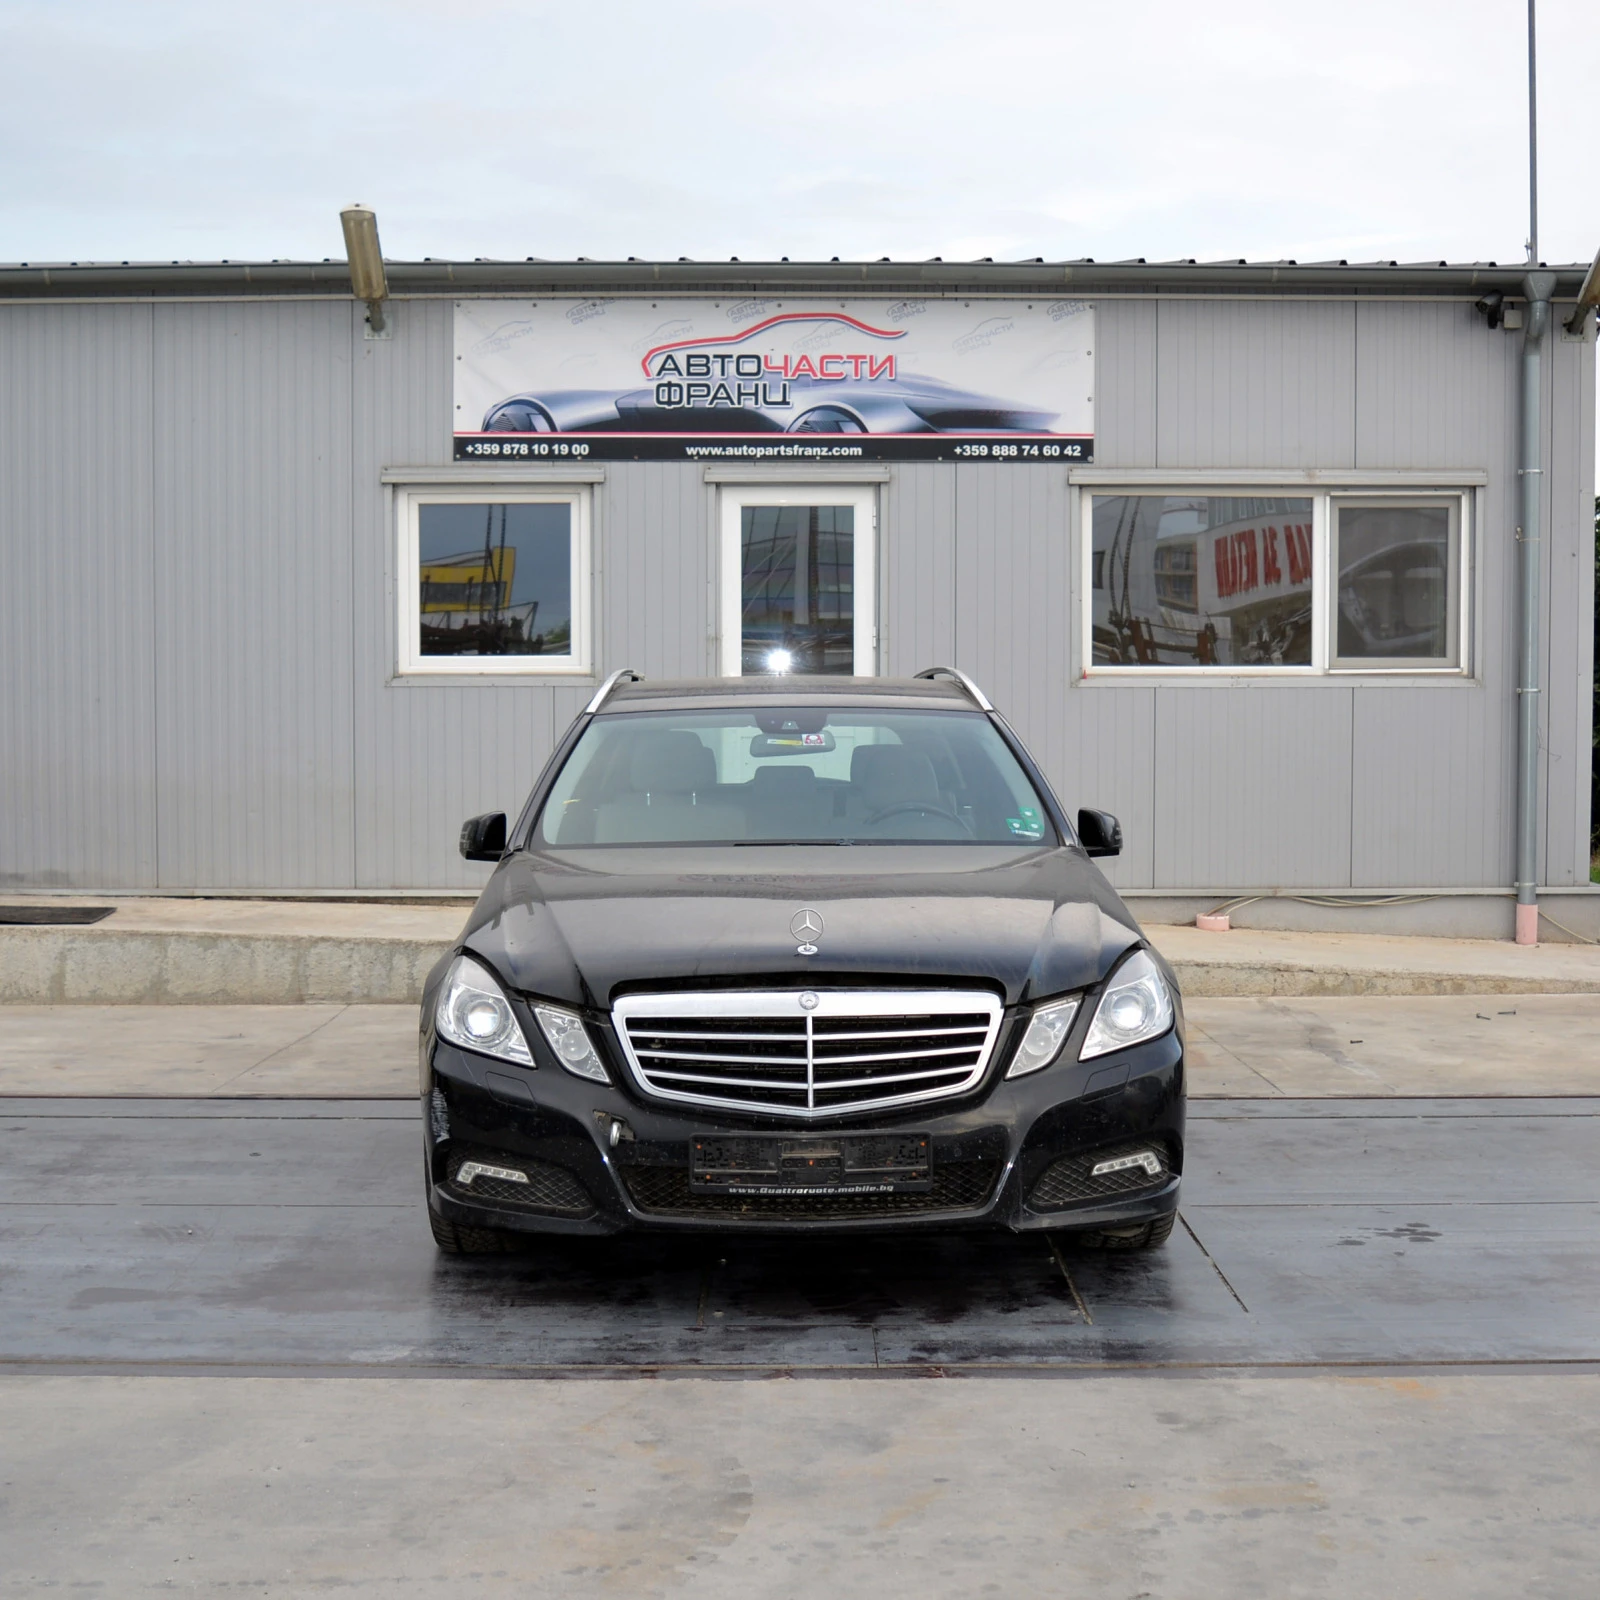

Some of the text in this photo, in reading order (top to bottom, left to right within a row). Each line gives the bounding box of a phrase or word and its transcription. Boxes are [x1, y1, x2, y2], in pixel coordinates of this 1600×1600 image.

[655, 353, 896, 379] АВТОЧАСТИ
[655, 380, 791, 408] ФРАНЦ
[465, 443, 590, 455] +359 878 10 19 00
[685, 444, 863, 458] www.autopartsfranz.com
[953, 445, 1082, 457] +359 888 74 60 42
